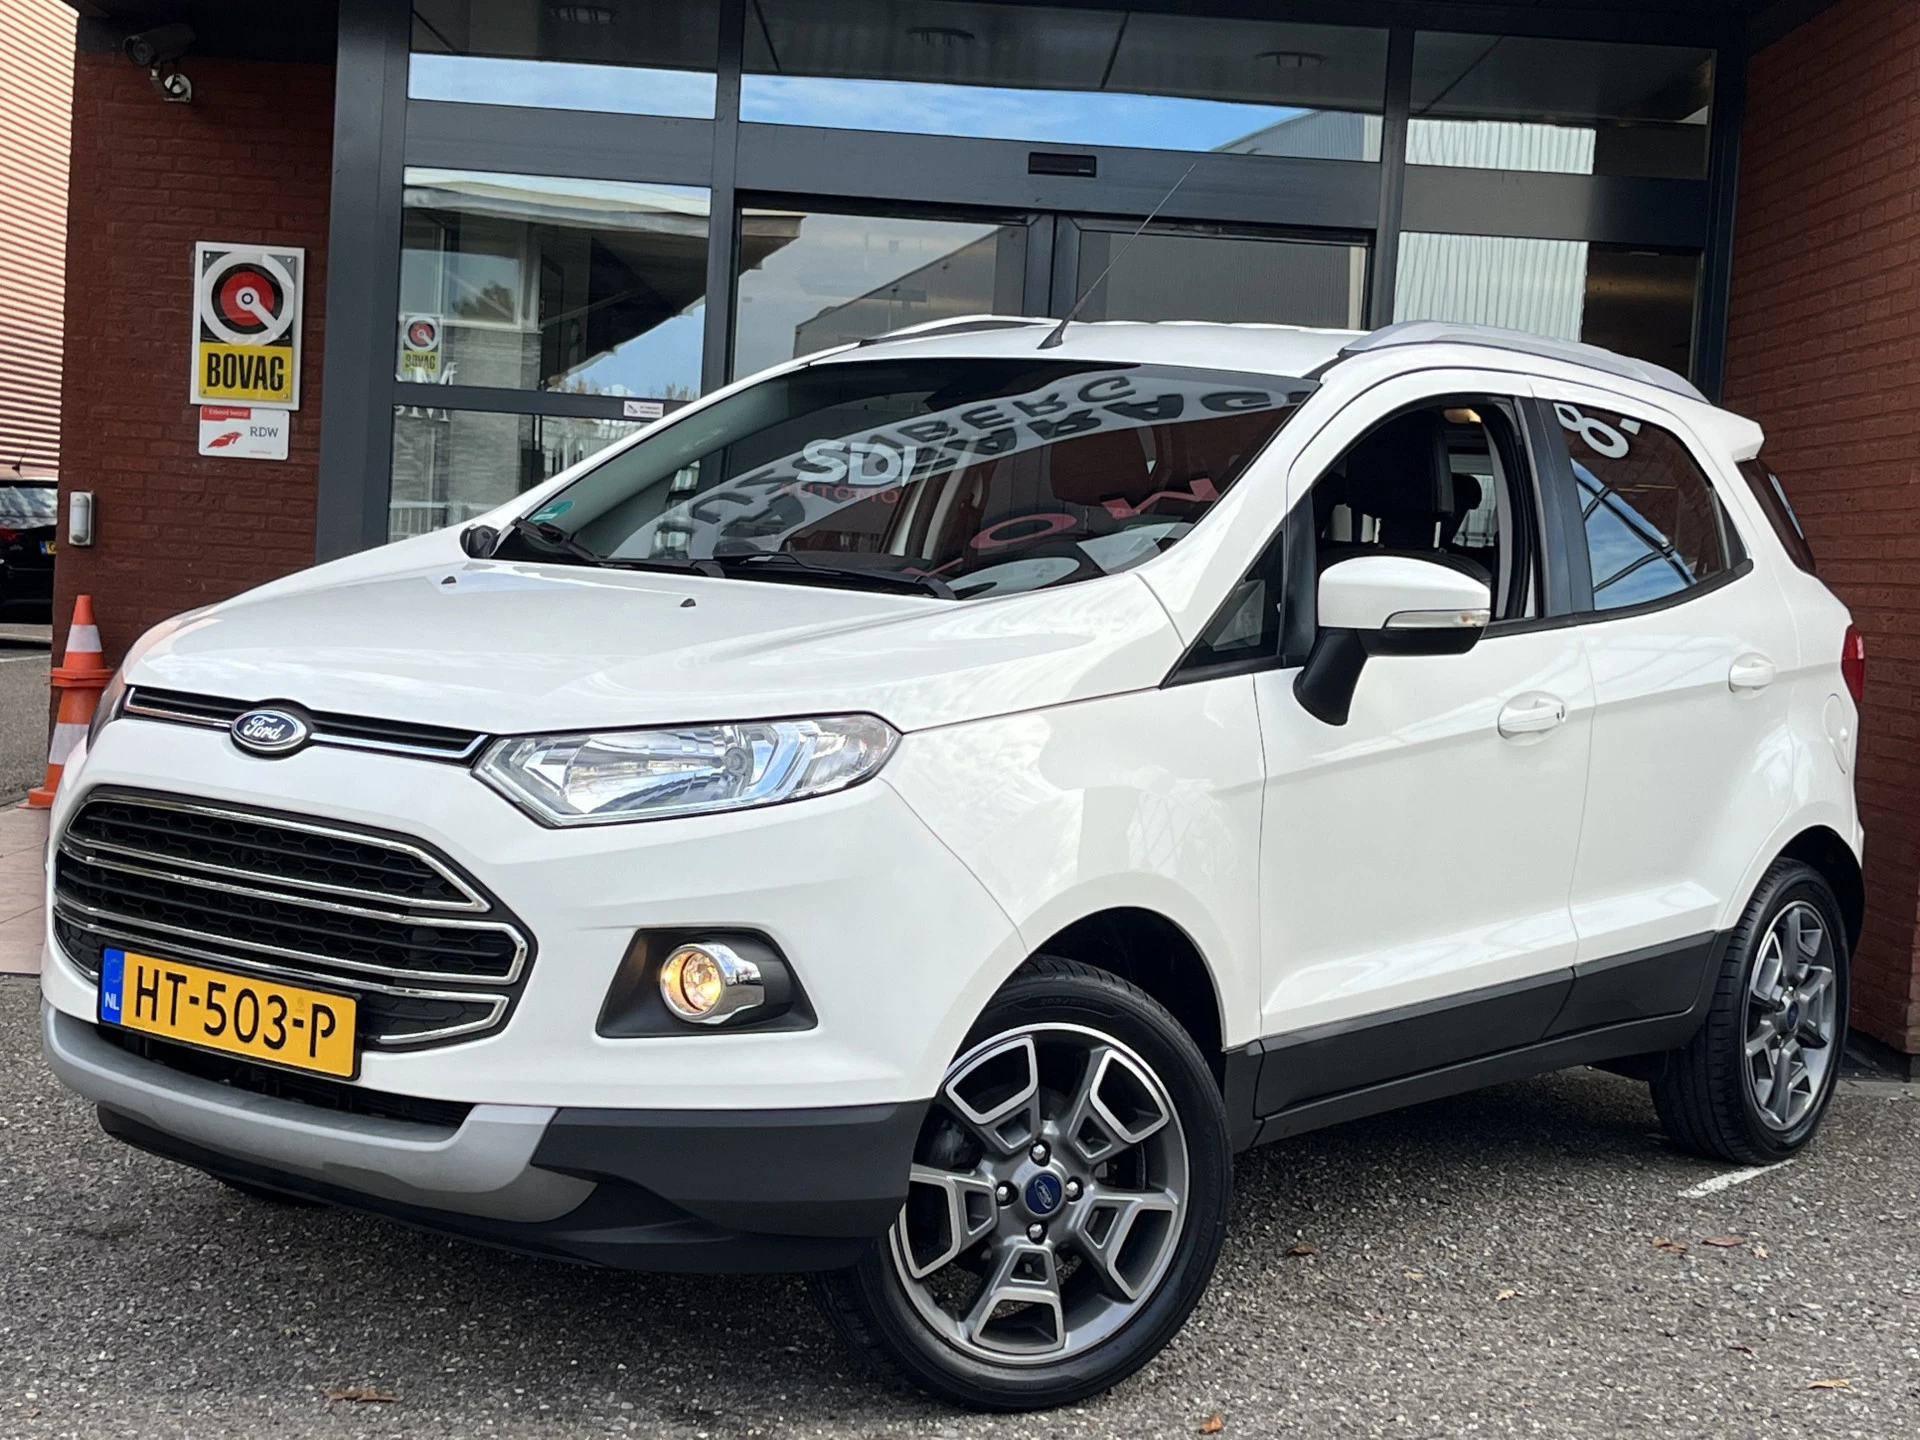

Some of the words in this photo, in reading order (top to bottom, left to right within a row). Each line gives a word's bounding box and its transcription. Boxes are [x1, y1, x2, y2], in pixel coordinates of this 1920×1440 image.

[206, 352, 285, 392] BOVAG
[249, 426, 279, 438] RDW
[796, 438, 918, 488] SDI
[242, 715, 286, 741] Ford
[104, 991, 120, 1011] NL
[134, 965, 337, 1058] HT-503-P
